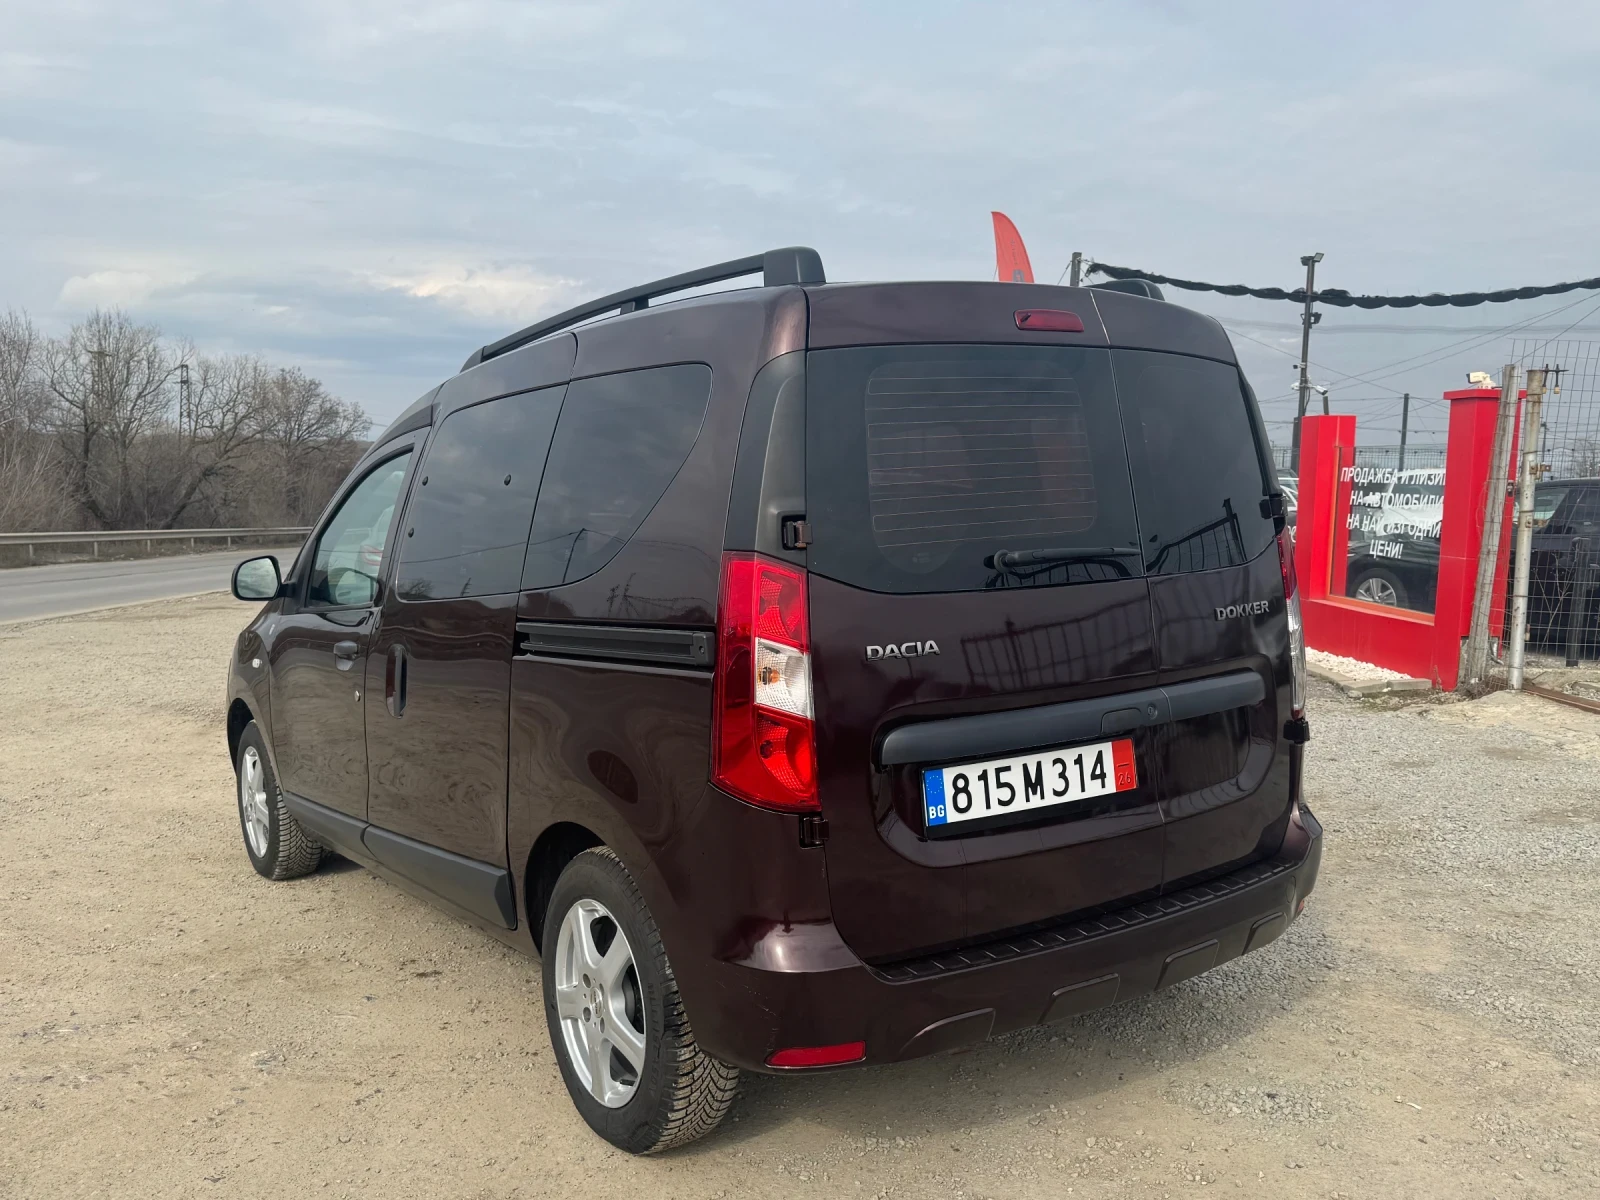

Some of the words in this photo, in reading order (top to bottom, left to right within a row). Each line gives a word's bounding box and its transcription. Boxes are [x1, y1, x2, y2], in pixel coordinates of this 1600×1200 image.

[1340, 467, 1398, 487] ПРОДАЖБА
[1400, 468, 1410, 485] И
[1349, 490, 1364, 506] НА
[1365, 491, 1445, 510] АВТОМОБИЛИ
[1346, 513, 1360, 530] НА
[1369, 539, 1404, 559] ЦЕНИ!
[1214, 600, 1270, 622] DOKKER
[865, 639, 940, 662] DACIA
[928, 804, 945, 820] BG
